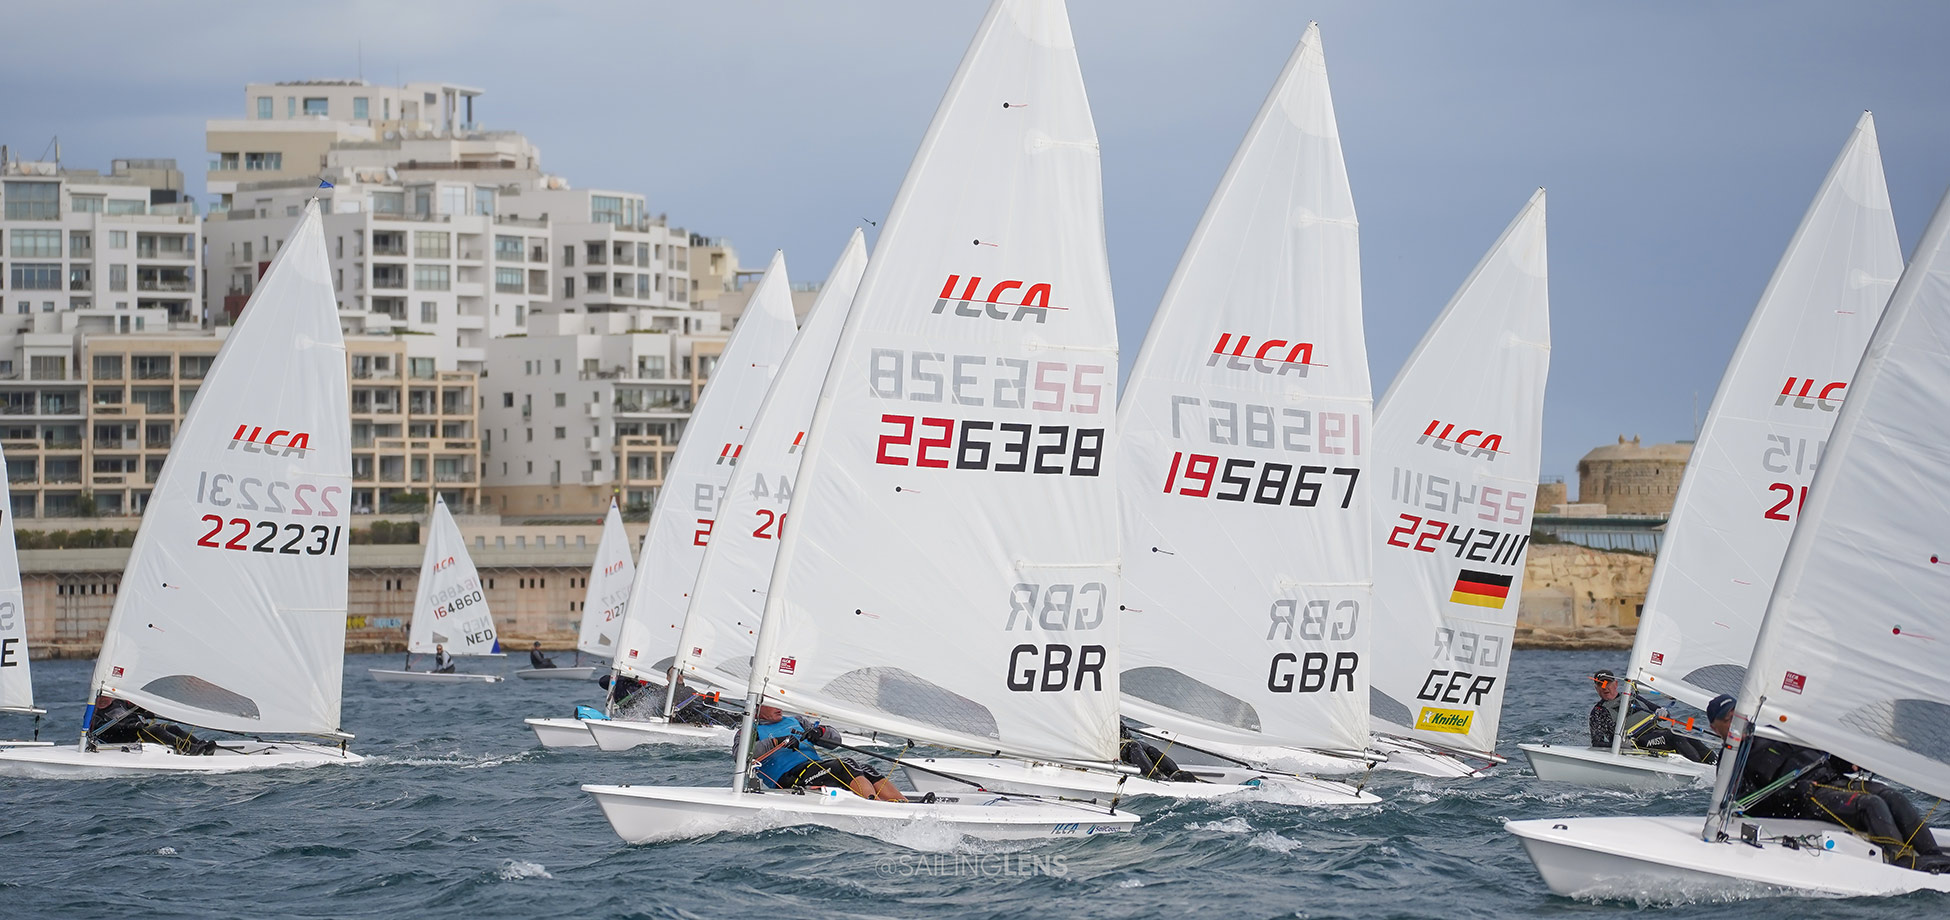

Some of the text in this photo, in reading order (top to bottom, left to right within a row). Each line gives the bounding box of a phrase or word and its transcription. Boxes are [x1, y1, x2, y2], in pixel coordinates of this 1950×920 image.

[931, 274, 1053, 324] ILCA
[1206, 332, 1315, 378] ILCA
[1774, 376, 1848, 412] ILC
[227, 423, 312, 460] ILCA
[876, 413, 1105, 477] 226328
[1416, 419, 1503, 462] ILCA
[1163, 451, 1360, 509] 195867
[197, 513, 342, 556] 222231
[1386, 512, 1531, 566] 2242111
[433, 556, 456, 575] ILCA
[605, 560, 624, 578] ILCA
[433, 590, 482, 620] 164860
[465, 629, 493, 646] NED
[1006, 643, 1107, 693] GBR
[1267, 651, 1360, 694] GBR
[1416, 669, 1497, 706] GER
